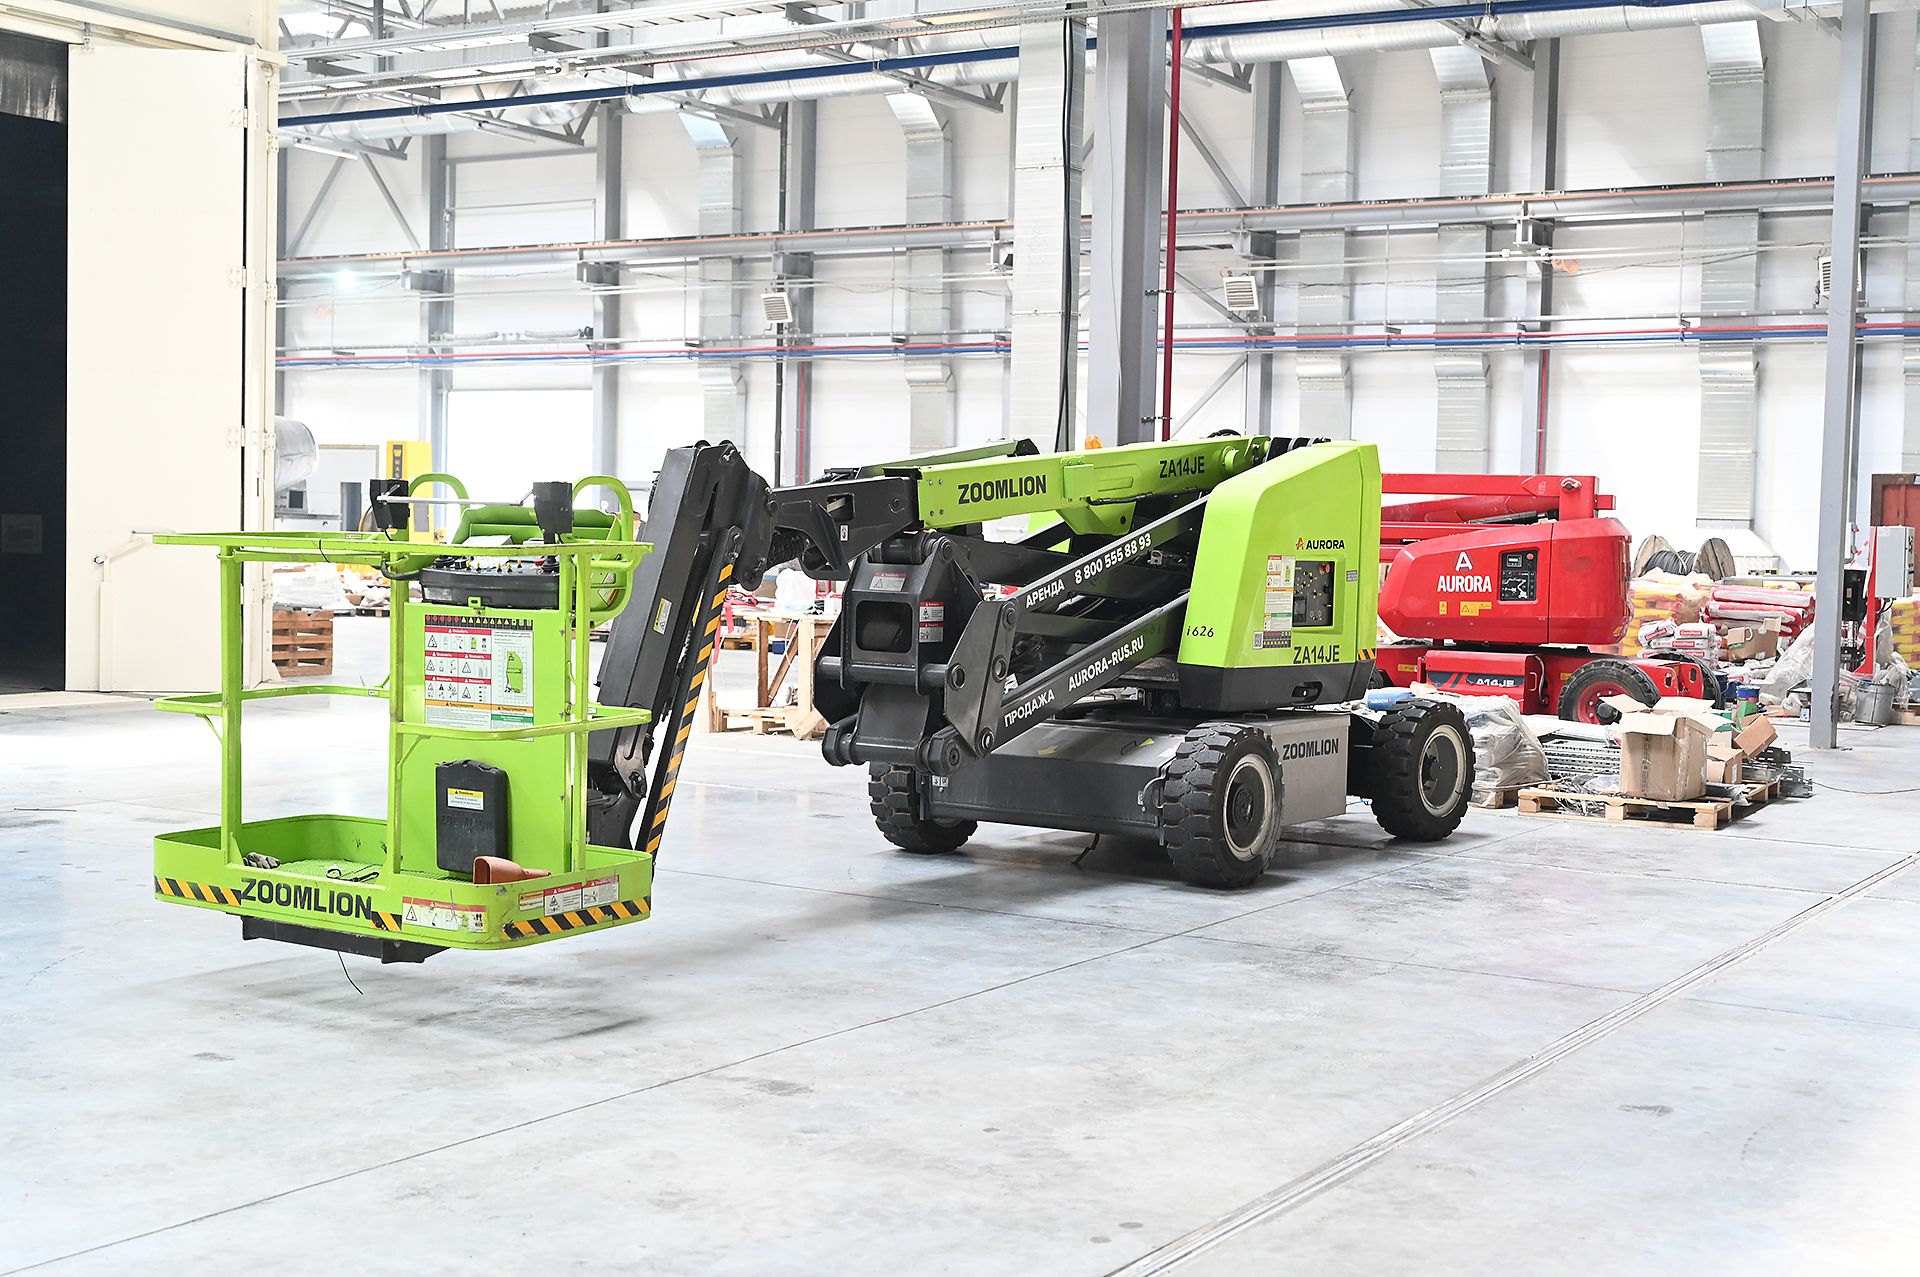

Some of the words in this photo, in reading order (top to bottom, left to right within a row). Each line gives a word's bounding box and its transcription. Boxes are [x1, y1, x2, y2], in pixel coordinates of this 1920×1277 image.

[1160, 456, 1205, 478] ZA14JE
[958, 474, 1047, 504] ZOOMLION
[1306, 540, 1345, 550] AURORA
[1074, 569, 1083, 584] 8
[1083, 559, 1103, 580] 800
[1104, 547, 1124, 568] 555
[1124, 540, 1138, 558] 88
[1138, 532, 1152, 550] 93
[1026, 579, 1065, 608] АРЕНДА
[1437, 575, 1492, 592] AURORA
[1186, 625, 1214, 638] i626
[1068, 634, 1144, 691] AURORA-RUS.RU
[1293, 645, 1340, 664] ZA14JE
[1004, 689, 1055, 728] ПРОДАЖА
[1283, 738, 1339, 760] ZOOMLION
[241, 877, 372, 920] ZOOMLION
